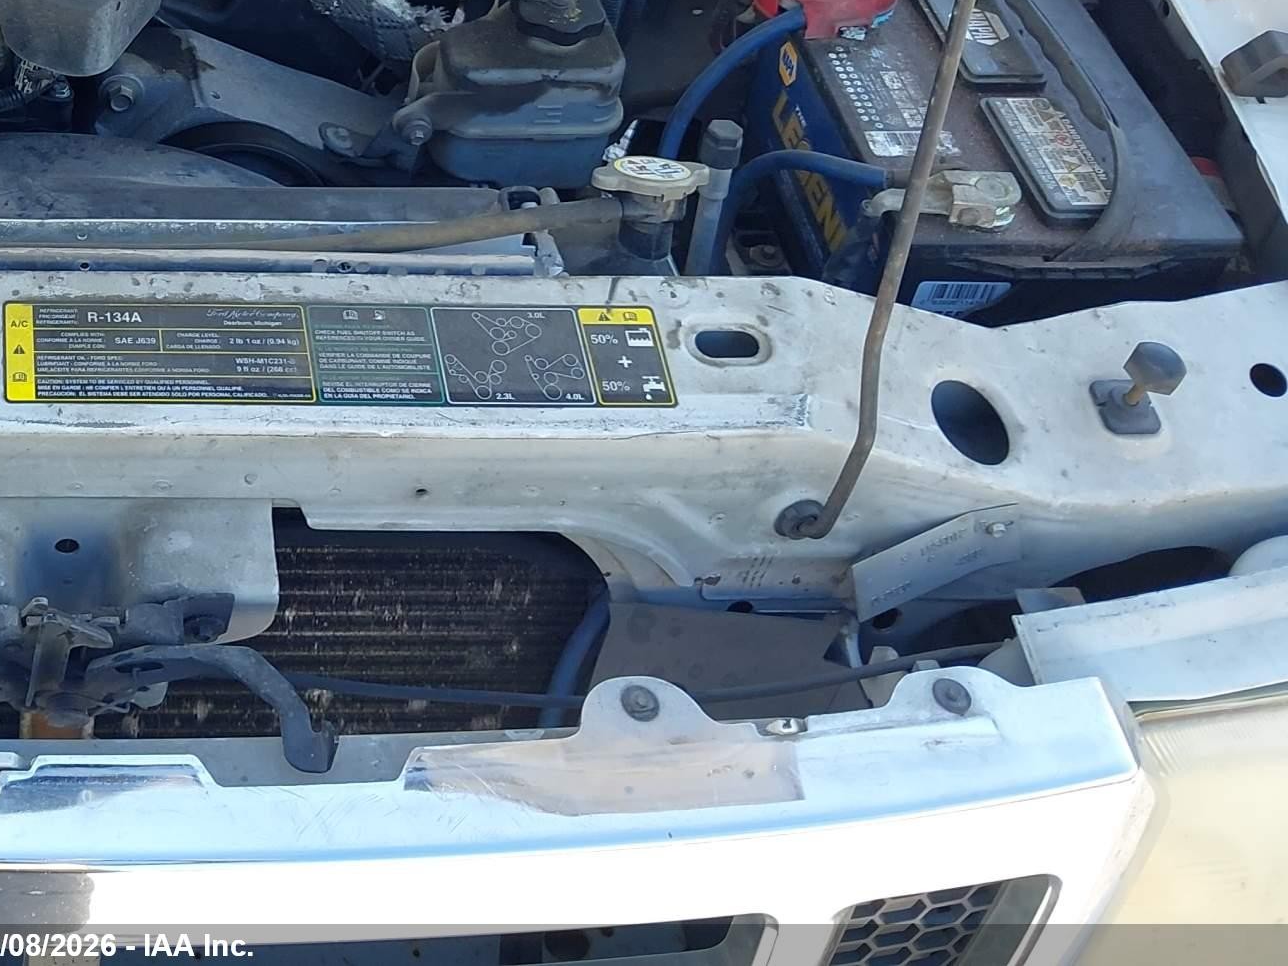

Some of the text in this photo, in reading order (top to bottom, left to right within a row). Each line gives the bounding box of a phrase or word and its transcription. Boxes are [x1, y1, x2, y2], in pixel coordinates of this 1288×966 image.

[87, 311, 142, 323] R-134A
[527, 311, 545, 319] 3.0L
[10, 320, 28, 328] A/C
[590, 334, 618, 345] 50%
[602, 381, 631, 392] 50%
